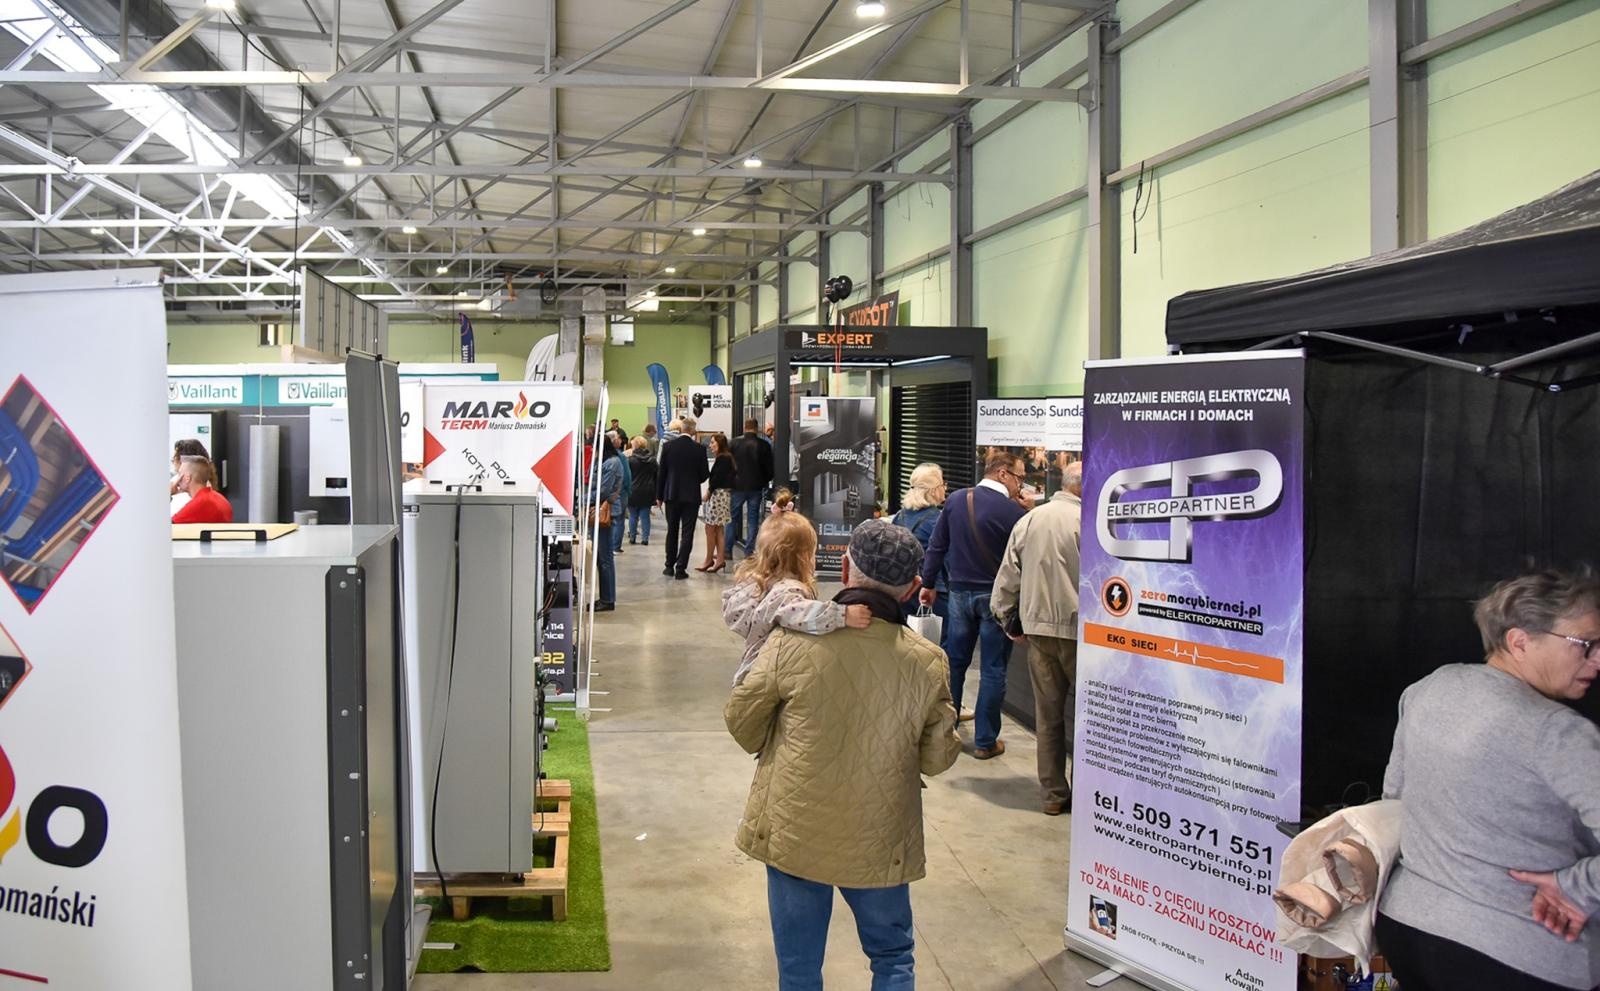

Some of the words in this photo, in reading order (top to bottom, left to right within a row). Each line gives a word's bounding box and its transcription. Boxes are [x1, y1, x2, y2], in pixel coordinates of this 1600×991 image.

[817, 333, 873, 345] EXPERT
[181, 384, 238, 399] Vaillant
[301, 382, 347, 398] Vaillan
[1093, 391, 1159, 407] ZARZĄDZANIE
[1161, 390, 1207, 406] ENERGIĄ
[1208, 388, 1292, 405] ELEKTRYCZNĄ
[441, 420, 488, 430] TERM
[488, 422, 513, 430] Mariusz
[514, 421, 547, 430] Domański
[979, 405, 1029, 416] Sundance
[1049, 404, 1085, 417] Sunda
[1122, 410, 1132, 421] W
[1134, 410, 1187, 421] FIRMACH
[1190, 409, 1195, 421] I
[1198, 409, 1254, 421] DOMACH
[816, 450, 858, 463] elegancja
[1107, 495, 1256, 517] ELEKTROPARTNER
[1140, 589, 1262, 618] zeromocybiernej.pl
[1166, 610, 1262, 633] ELEKTROPARTNER
[1107, 633, 1126, 645] EKG
[1131, 638, 1157, 651] SIECI
[1087, 698, 1115, 712] likwidacja
[1141, 713, 1155, 722] moc
[1156, 716, 1177, 729] bierną
[1088, 680, 1108, 691] analizy
[1109, 684, 1122, 693] sieci
[1127, 689, 1166, 704] sprawdzanie
[1168, 699, 1203, 714] poprawnej
[1204, 707, 1224, 719] pracy
[1225, 712, 1242, 722] sieci
[1088, 689, 1108, 700] analizy
[1109, 694, 1125, 704] faktur
[1135, 701, 1158, 713] energię
[1160, 706, 1198, 724] elektryczną
[1087, 708, 1115, 722] likwidacja
[1141, 723, 1185, 741] przekroczenie
[1187, 735, 1206, 748] mocy
[1086, 719, 1128, 735] rozwiązywanie
[1129, 730, 1164, 745] problemów
[1171, 742, 1219, 760] wyłączającymi
[1221, 755, 1232, 766] się
[1233, 758, 1278, 777] falownikami
[1092, 729, 1126, 745] instalacjach
[1127, 740, 1182, 760] fotowoltaicznych
[1085, 749, 1123, 765] urządzeniami
[1124, 760, 1150, 773] podczas
[1151, 768, 1167, 779] taryf
[1168, 773, 1217, 793] dynamicznych
[1108, 745, 1138, 759] systemów
[1139, 754, 1183, 772] generujących
[1184, 767, 1231, 787] oszczędności
[1232, 781, 1276, 799] (sterowania
[1135, 774, 1172, 790] sterujących
[1174, 785, 1230, 810] autokonsumpcją
[1232, 803, 1248, 815] przy
[1094, 790, 1124, 815] tel.
[1132, 803, 1171, 830] 509
[1179, 818, 1218, 847] 371
[1229, 834, 1272, 865] 551
[1093, 811, 1272, 881] www.elektropartner.info.pl
[1094, 824, 1272, 896] www.zeromocybiernej.pl
[1080, 870, 1094, 885] TO
[1096, 877, 1110, 892] ZA
[1112, 885, 1145, 907] MAŁO
[1154, 901, 1205, 931] ZACZNIJ
[1208, 922, 1266, 956] DZIAŁAĆ
[1094, 861, 1150, 894] MYŚLENIE
[1152, 885, 1161, 898] O
[1164, 889, 1205, 915] CIĘCIU
[1208, 906, 1276, 943] KOSZTÓW
[1235, 968, 1264, 987] Adam
